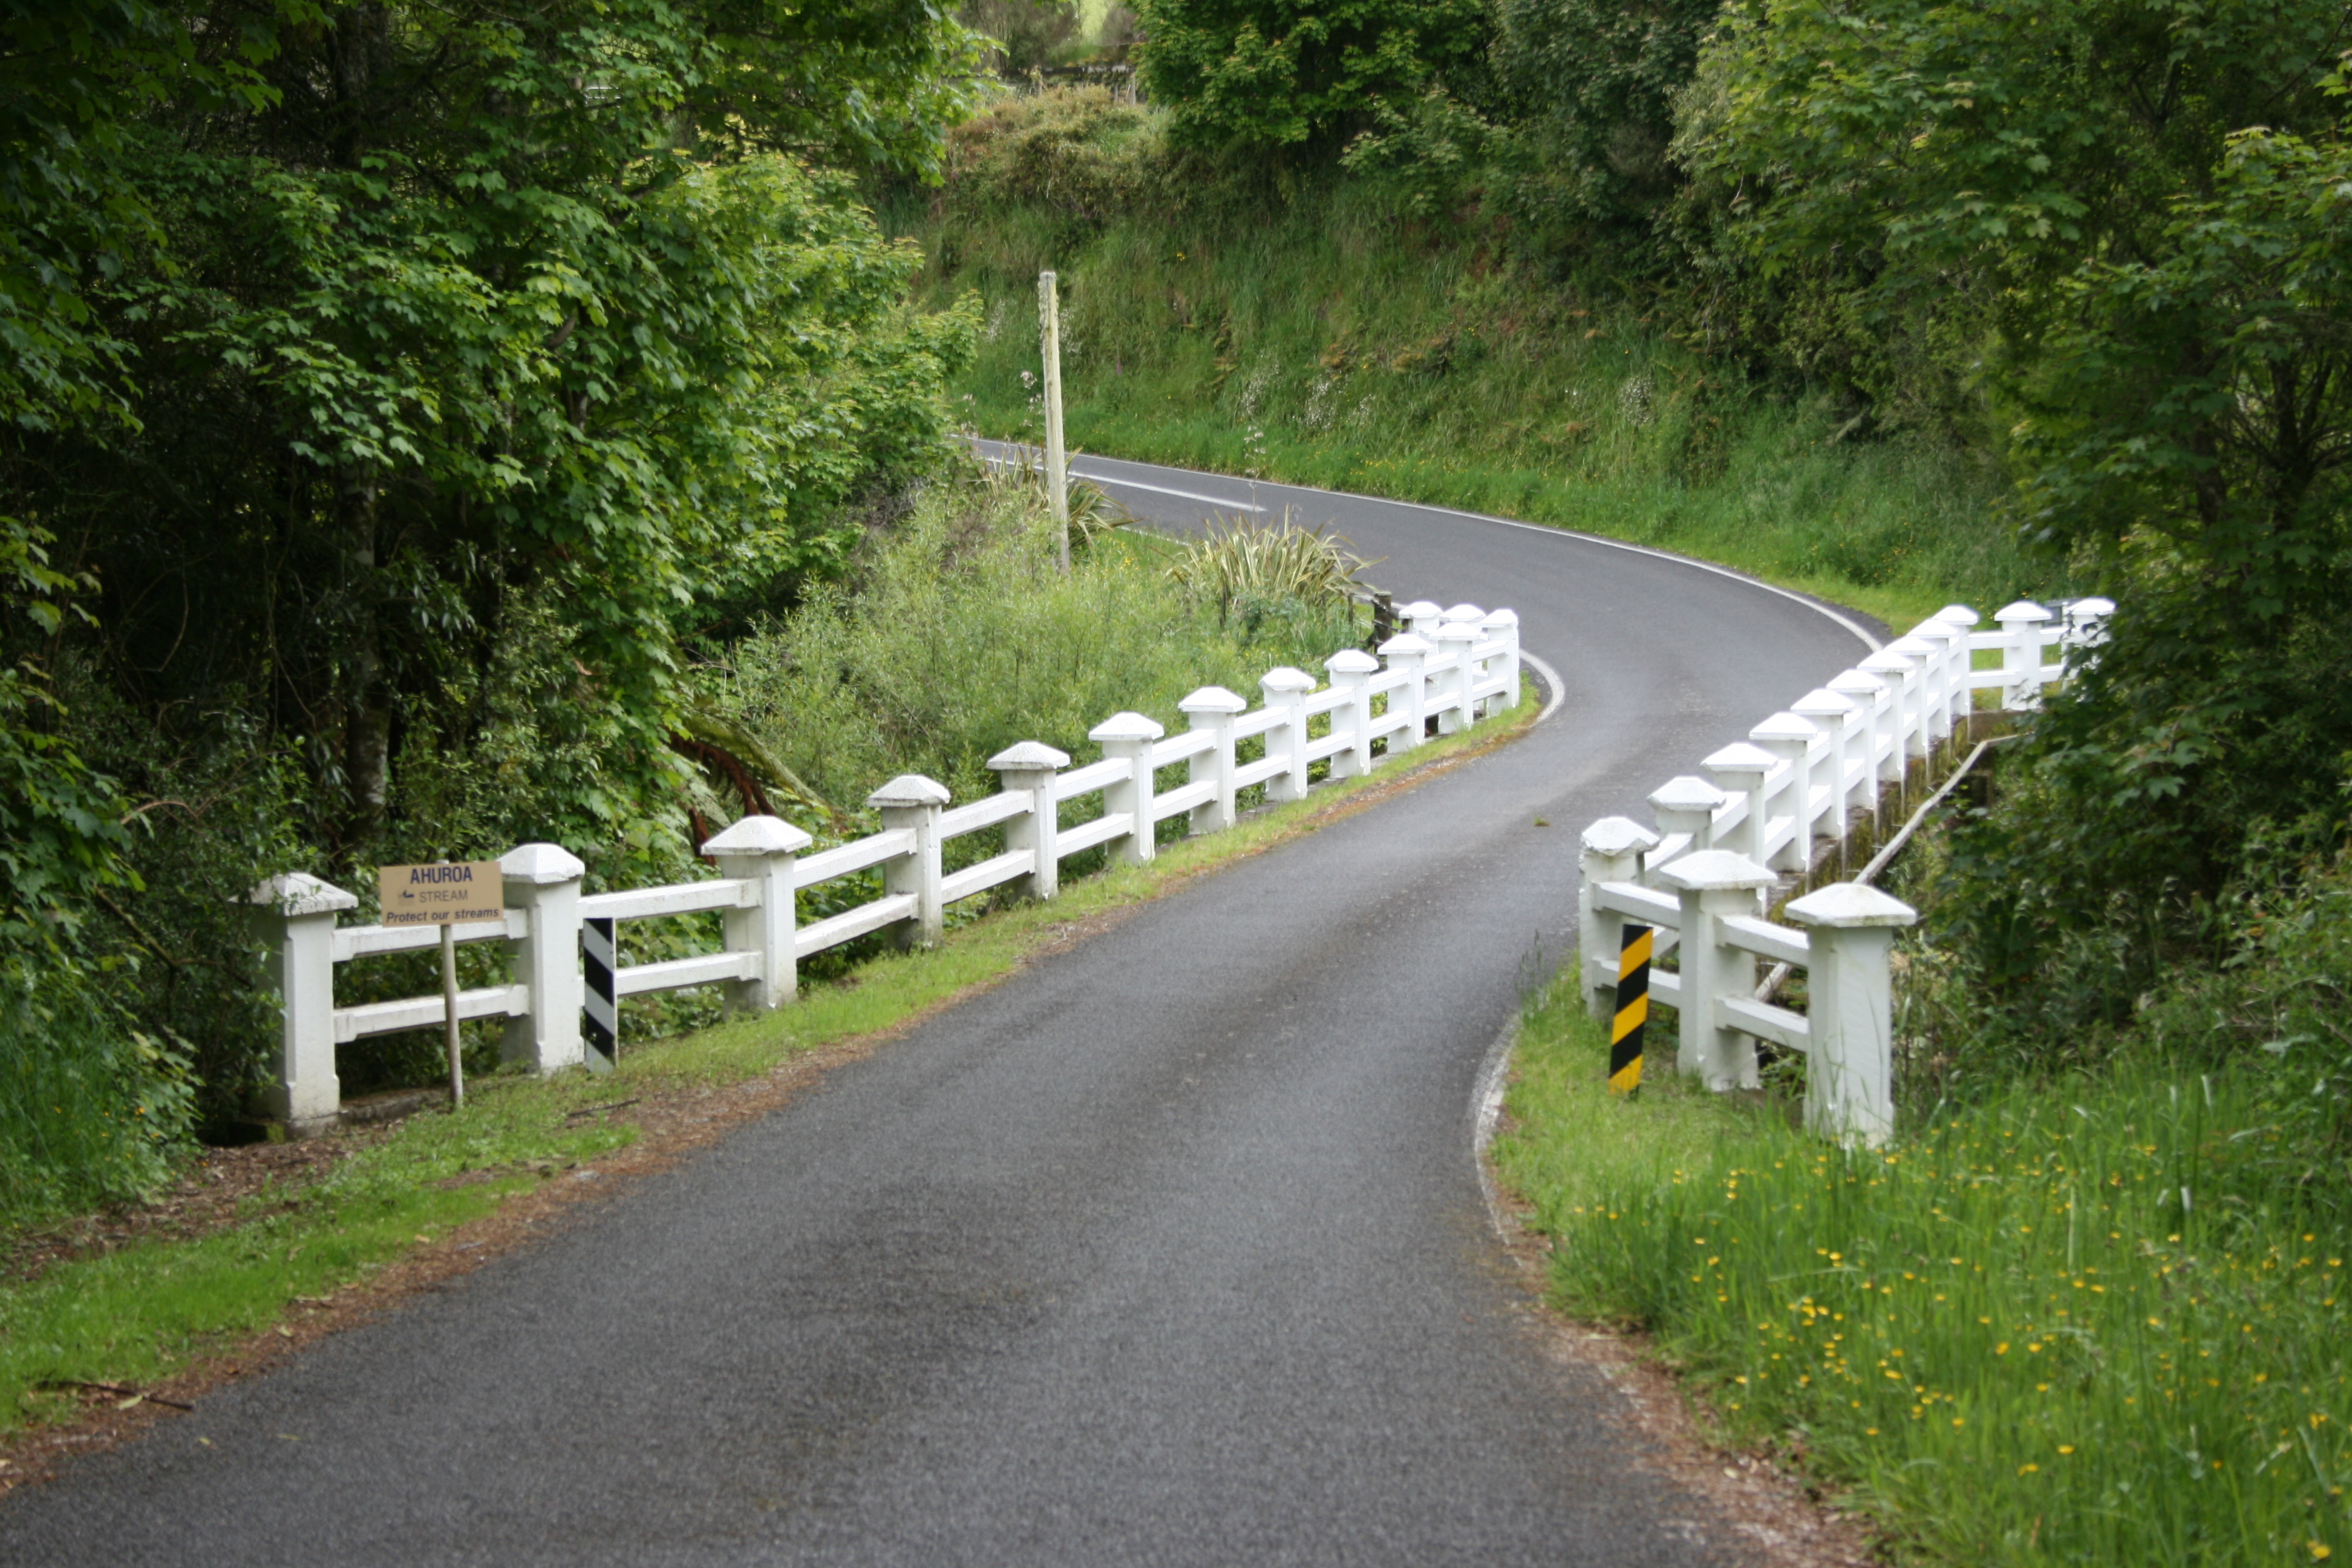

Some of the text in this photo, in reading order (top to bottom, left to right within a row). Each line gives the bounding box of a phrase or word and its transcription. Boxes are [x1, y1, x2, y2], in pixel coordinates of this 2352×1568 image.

[410, 866, 473, 884] AHUROA
[419, 890, 468, 903] STREAM
[386, 909, 499, 923] Protect our streams
